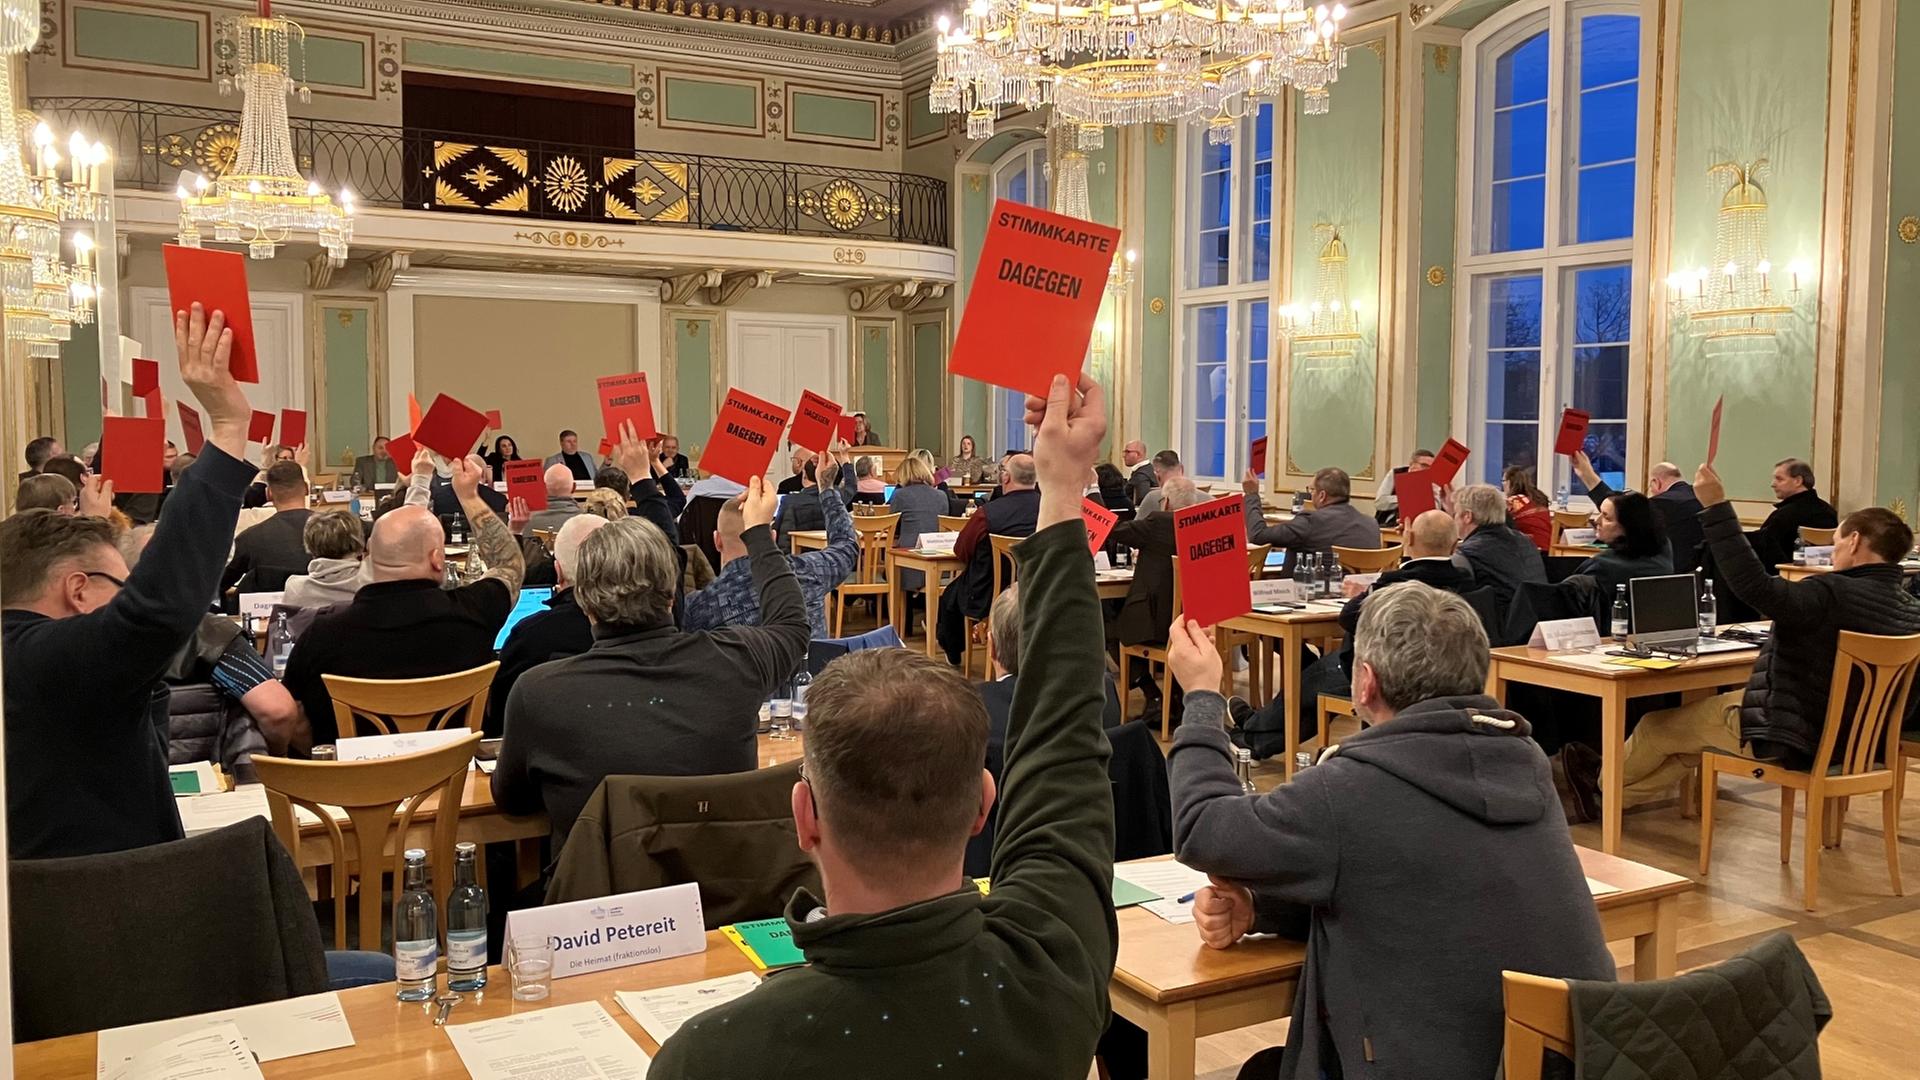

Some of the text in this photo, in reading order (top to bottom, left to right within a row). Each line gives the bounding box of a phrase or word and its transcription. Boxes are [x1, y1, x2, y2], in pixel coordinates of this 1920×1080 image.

[998, 212, 1111, 253] STIMMKARTE
[998, 259, 1082, 299] DAGEGEN
[726, 398, 785, 427] STIMMKARTE
[804, 394, 839, 414] STIMMKARTE
[804, 408, 831, 426] DAGEGEN
[726, 422, 767, 447] DAGEGEN
[1178, 503, 1241, 529] STIMMKARTE
[1189, 534, 1236, 561] DAGEGEN
[546, 916, 677, 952] David Petereit
[569, 945, 662, 969] Die Heimat (fraktionslos)
